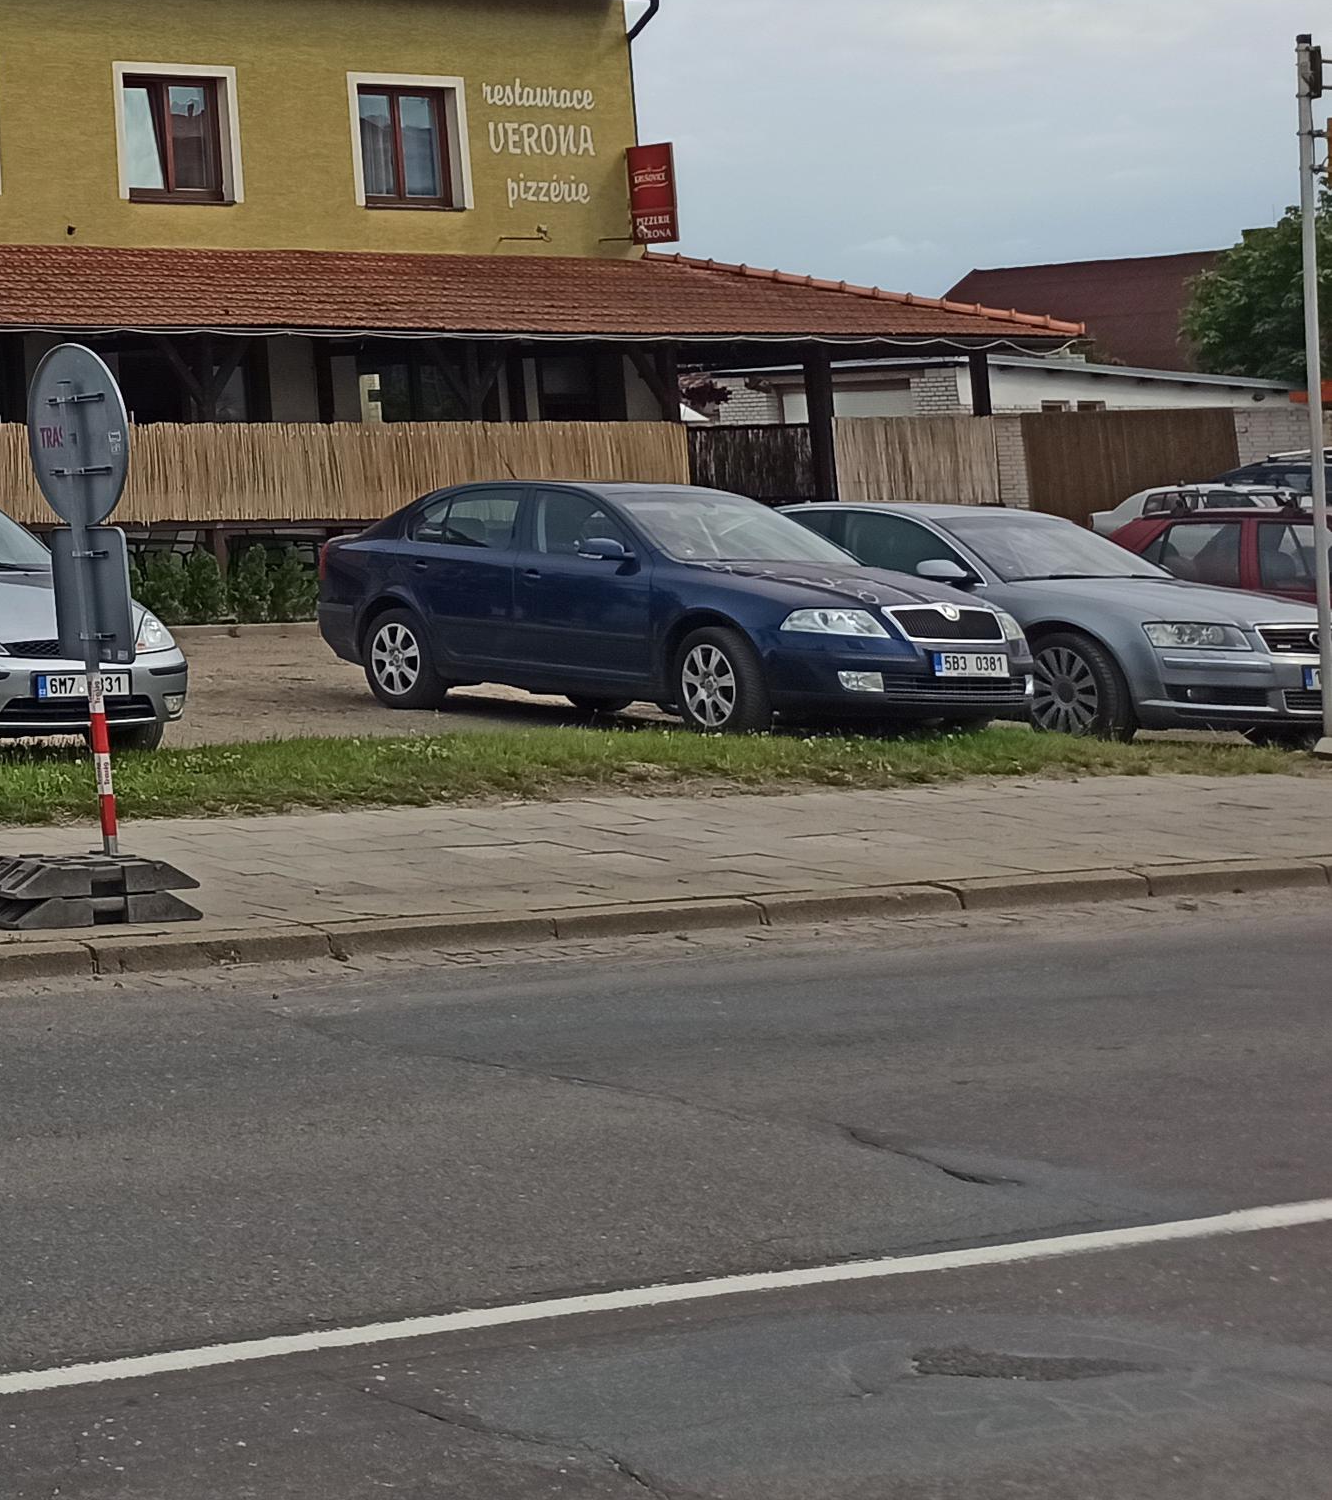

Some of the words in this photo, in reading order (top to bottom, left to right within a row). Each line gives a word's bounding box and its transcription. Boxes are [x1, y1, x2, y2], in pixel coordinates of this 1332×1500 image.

[482, 78, 595, 110] restaurace
[488, 121, 596, 156] VERONA
[507, 172, 591, 208] pizzérie
[944, 655, 967, 671] 5B3
[976, 656, 1003, 671] 0381
[49, 677, 76, 694] 6M7
